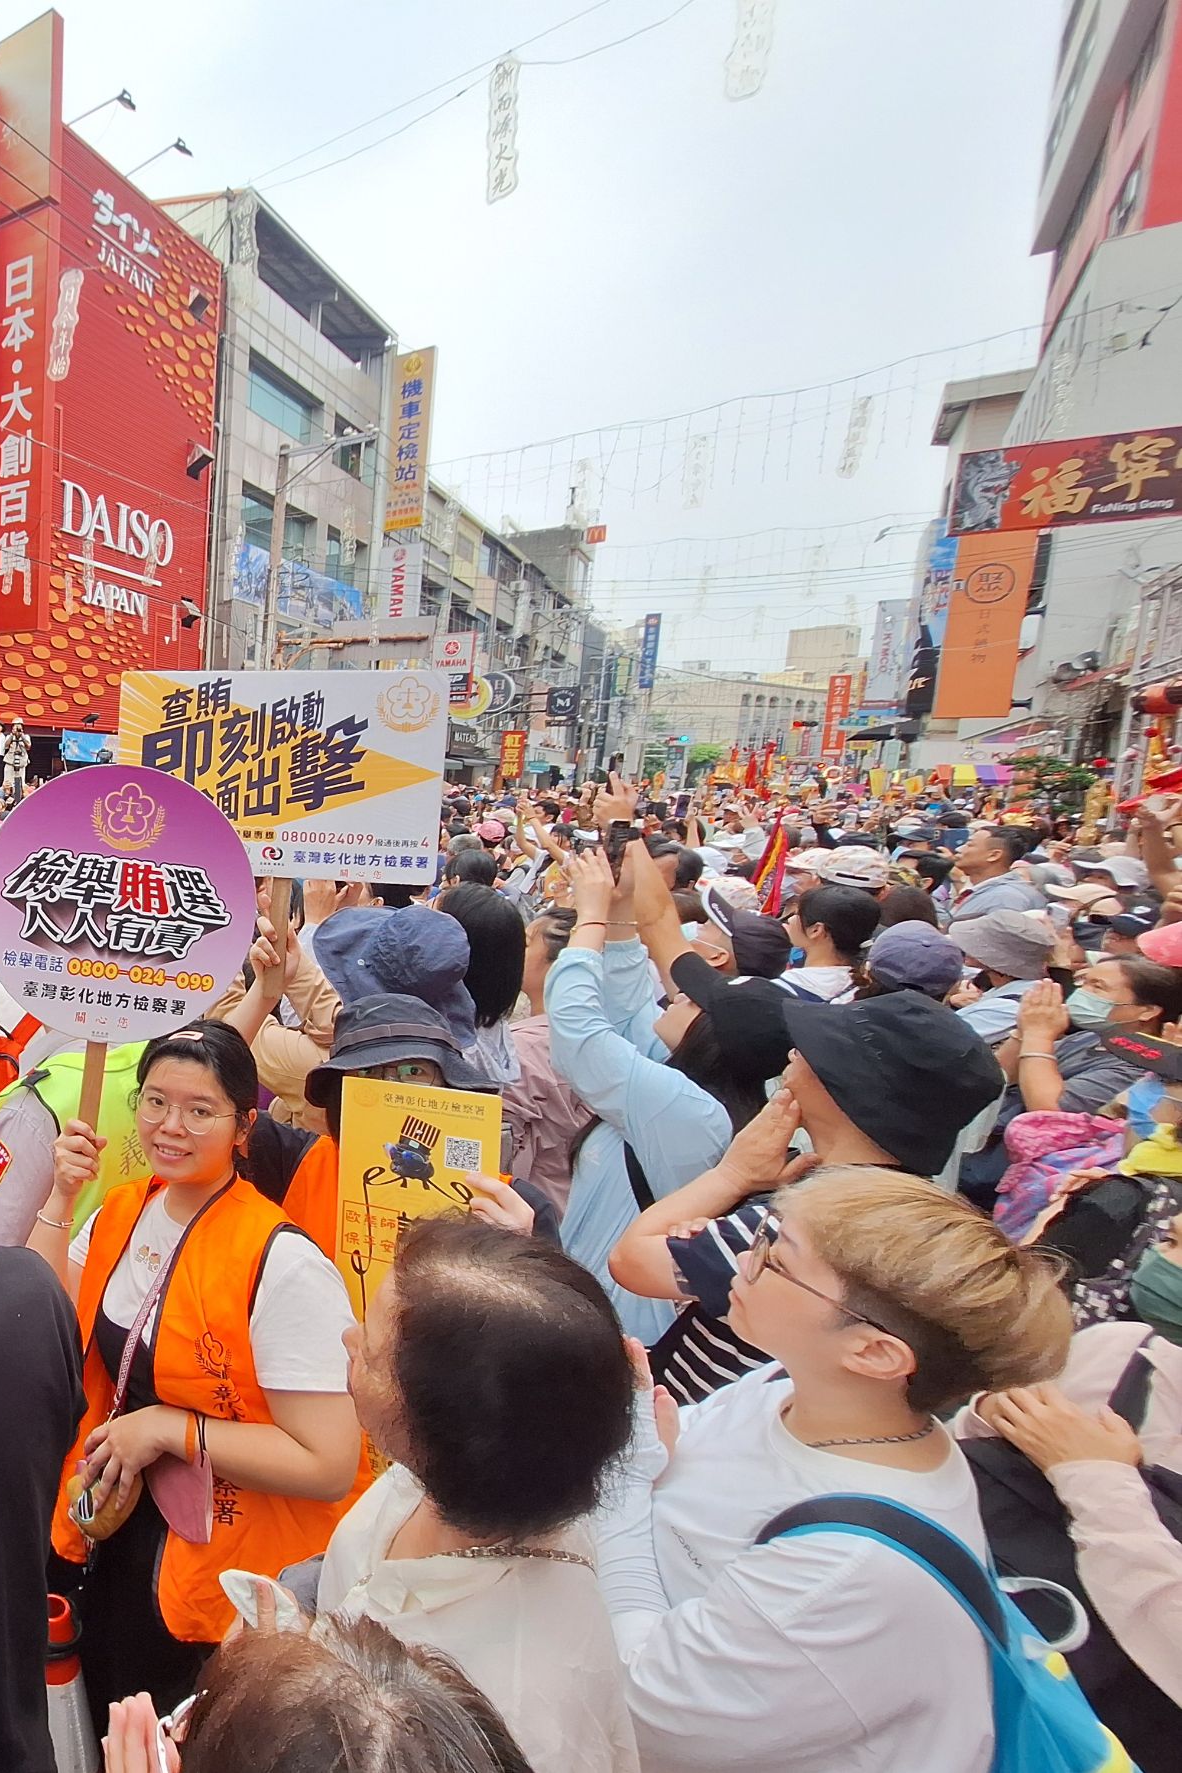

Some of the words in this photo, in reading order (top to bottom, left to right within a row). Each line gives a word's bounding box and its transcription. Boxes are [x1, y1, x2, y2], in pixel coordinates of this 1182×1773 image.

[92, 188, 160, 258] ダイソー
[97, 241, 155, 298] JAPAN
[394, 377, 425, 483] 機車定檢站
[1019, 434, 1182, 518] 福寧
[60, 478, 174, 567] DAISO
[1090, 501, 1137, 515] FuNing
[81, 578, 147, 617] JAPAN
[435, 658, 467, 668] YAMAHA
[878, 632, 893, 674] KYMCO
[160, 677, 233, 729] 查賄
[201, 715, 369, 822] 面出擊
[501, 734, 523, 777] 紅豆餅
[281, 830, 374, 845] 0800024099
[420, 836, 430, 848] 4
[293, 850, 430, 869] 臺灣彰化地方檢察署
[4, 849, 230, 925] 檢舉賄選
[20, 901, 204, 958] 人人有責
[2, 949, 63, 973] 檢舉電話
[67, 957, 215, 992] 0800-024-099
[22, 980, 188, 1016] 臺灣彰化地方檢察署
[75, 1011, 129, 1028] 關心您
[383, 1092, 486, 1117] 臺灣彰化地方檢察署
